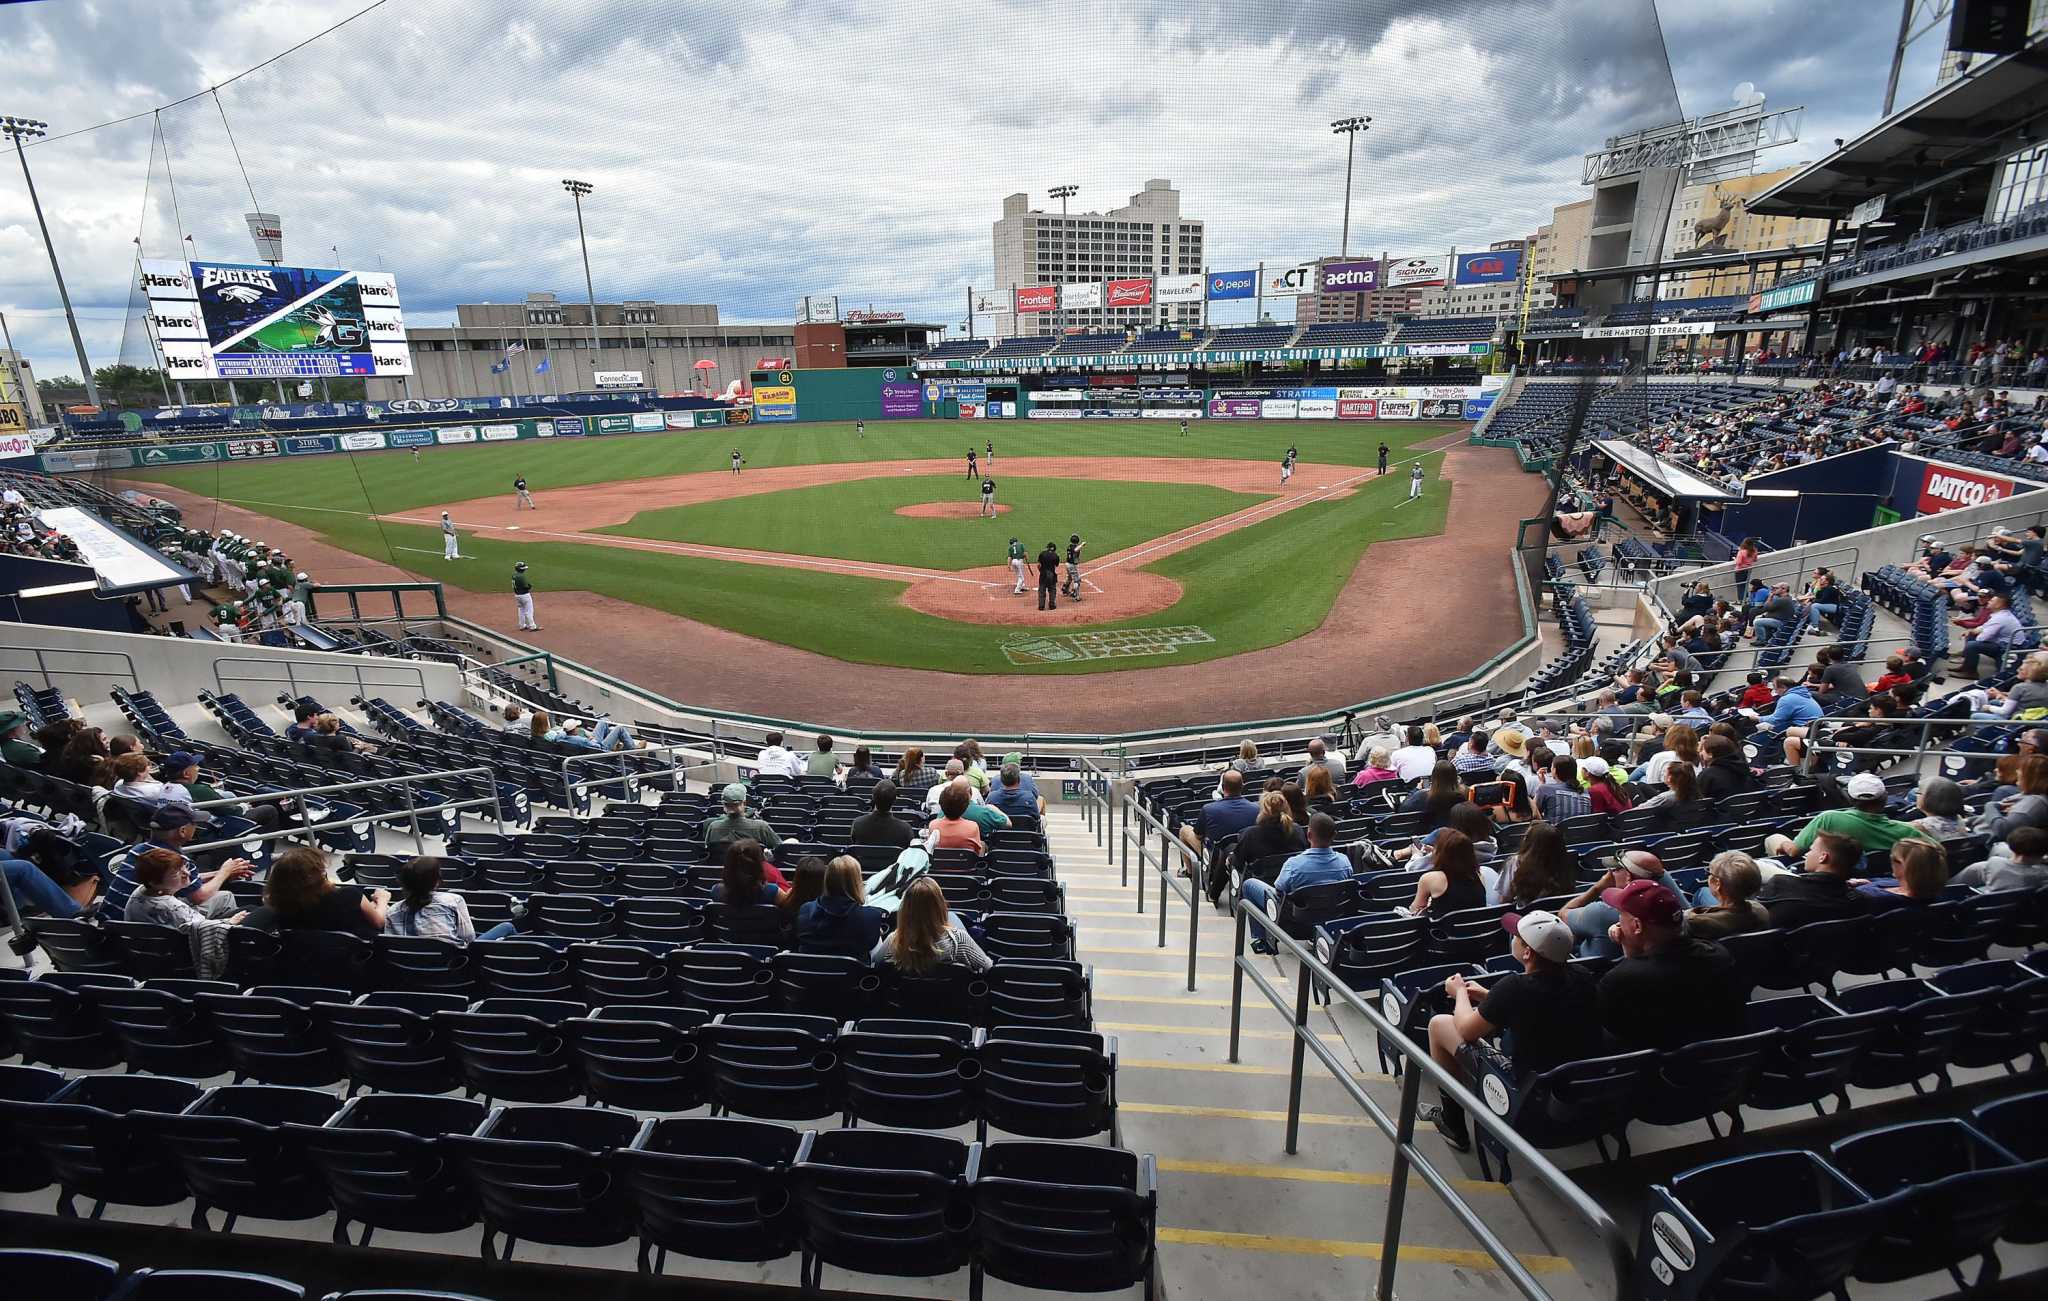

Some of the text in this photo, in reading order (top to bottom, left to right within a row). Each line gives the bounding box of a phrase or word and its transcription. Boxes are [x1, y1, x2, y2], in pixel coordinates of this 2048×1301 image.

[144, 274, 182, 287] Harc
[202, 266, 278, 293] EAGLES
[1285, 268, 1308, 287] CT
[1326, 269, 1374, 286] aetna
[359, 284, 388, 296] Harc
[1225, 279, 1251, 291] pepsi
[1159, 287, 1193, 296] TRAVELERS
[1019, 295, 1052, 305] Frontier
[154, 316, 193, 328] Harc
[367, 320, 396, 331] Harc
[1614, 328, 1656, 337] HARTFORD
[1658, 326, 1693, 335] TERRACE
[374, 356, 402, 366] Harc
[1011, 357, 1039, 367] TICKETS
[1056, 356, 1073, 366] SALE
[1101, 354, 1133, 364] TICKETS
[1215, 351, 1236, 361] CALL
[1318, 348, 1336, 359] FOR
[1341, 347, 1369, 358] MORE
[166, 357, 203, 370] Harc
[883, 371, 894, 379] 42
[1276, 390, 1318, 398] STRATIS
[1341, 403, 1373, 411] HARTFORD
[1381, 401, 1410, 410] Express
[0, 409, 20, 426] BQ
[1927, 473, 1986, 507] DATTCO
[220, 609, 227, 619] 9
